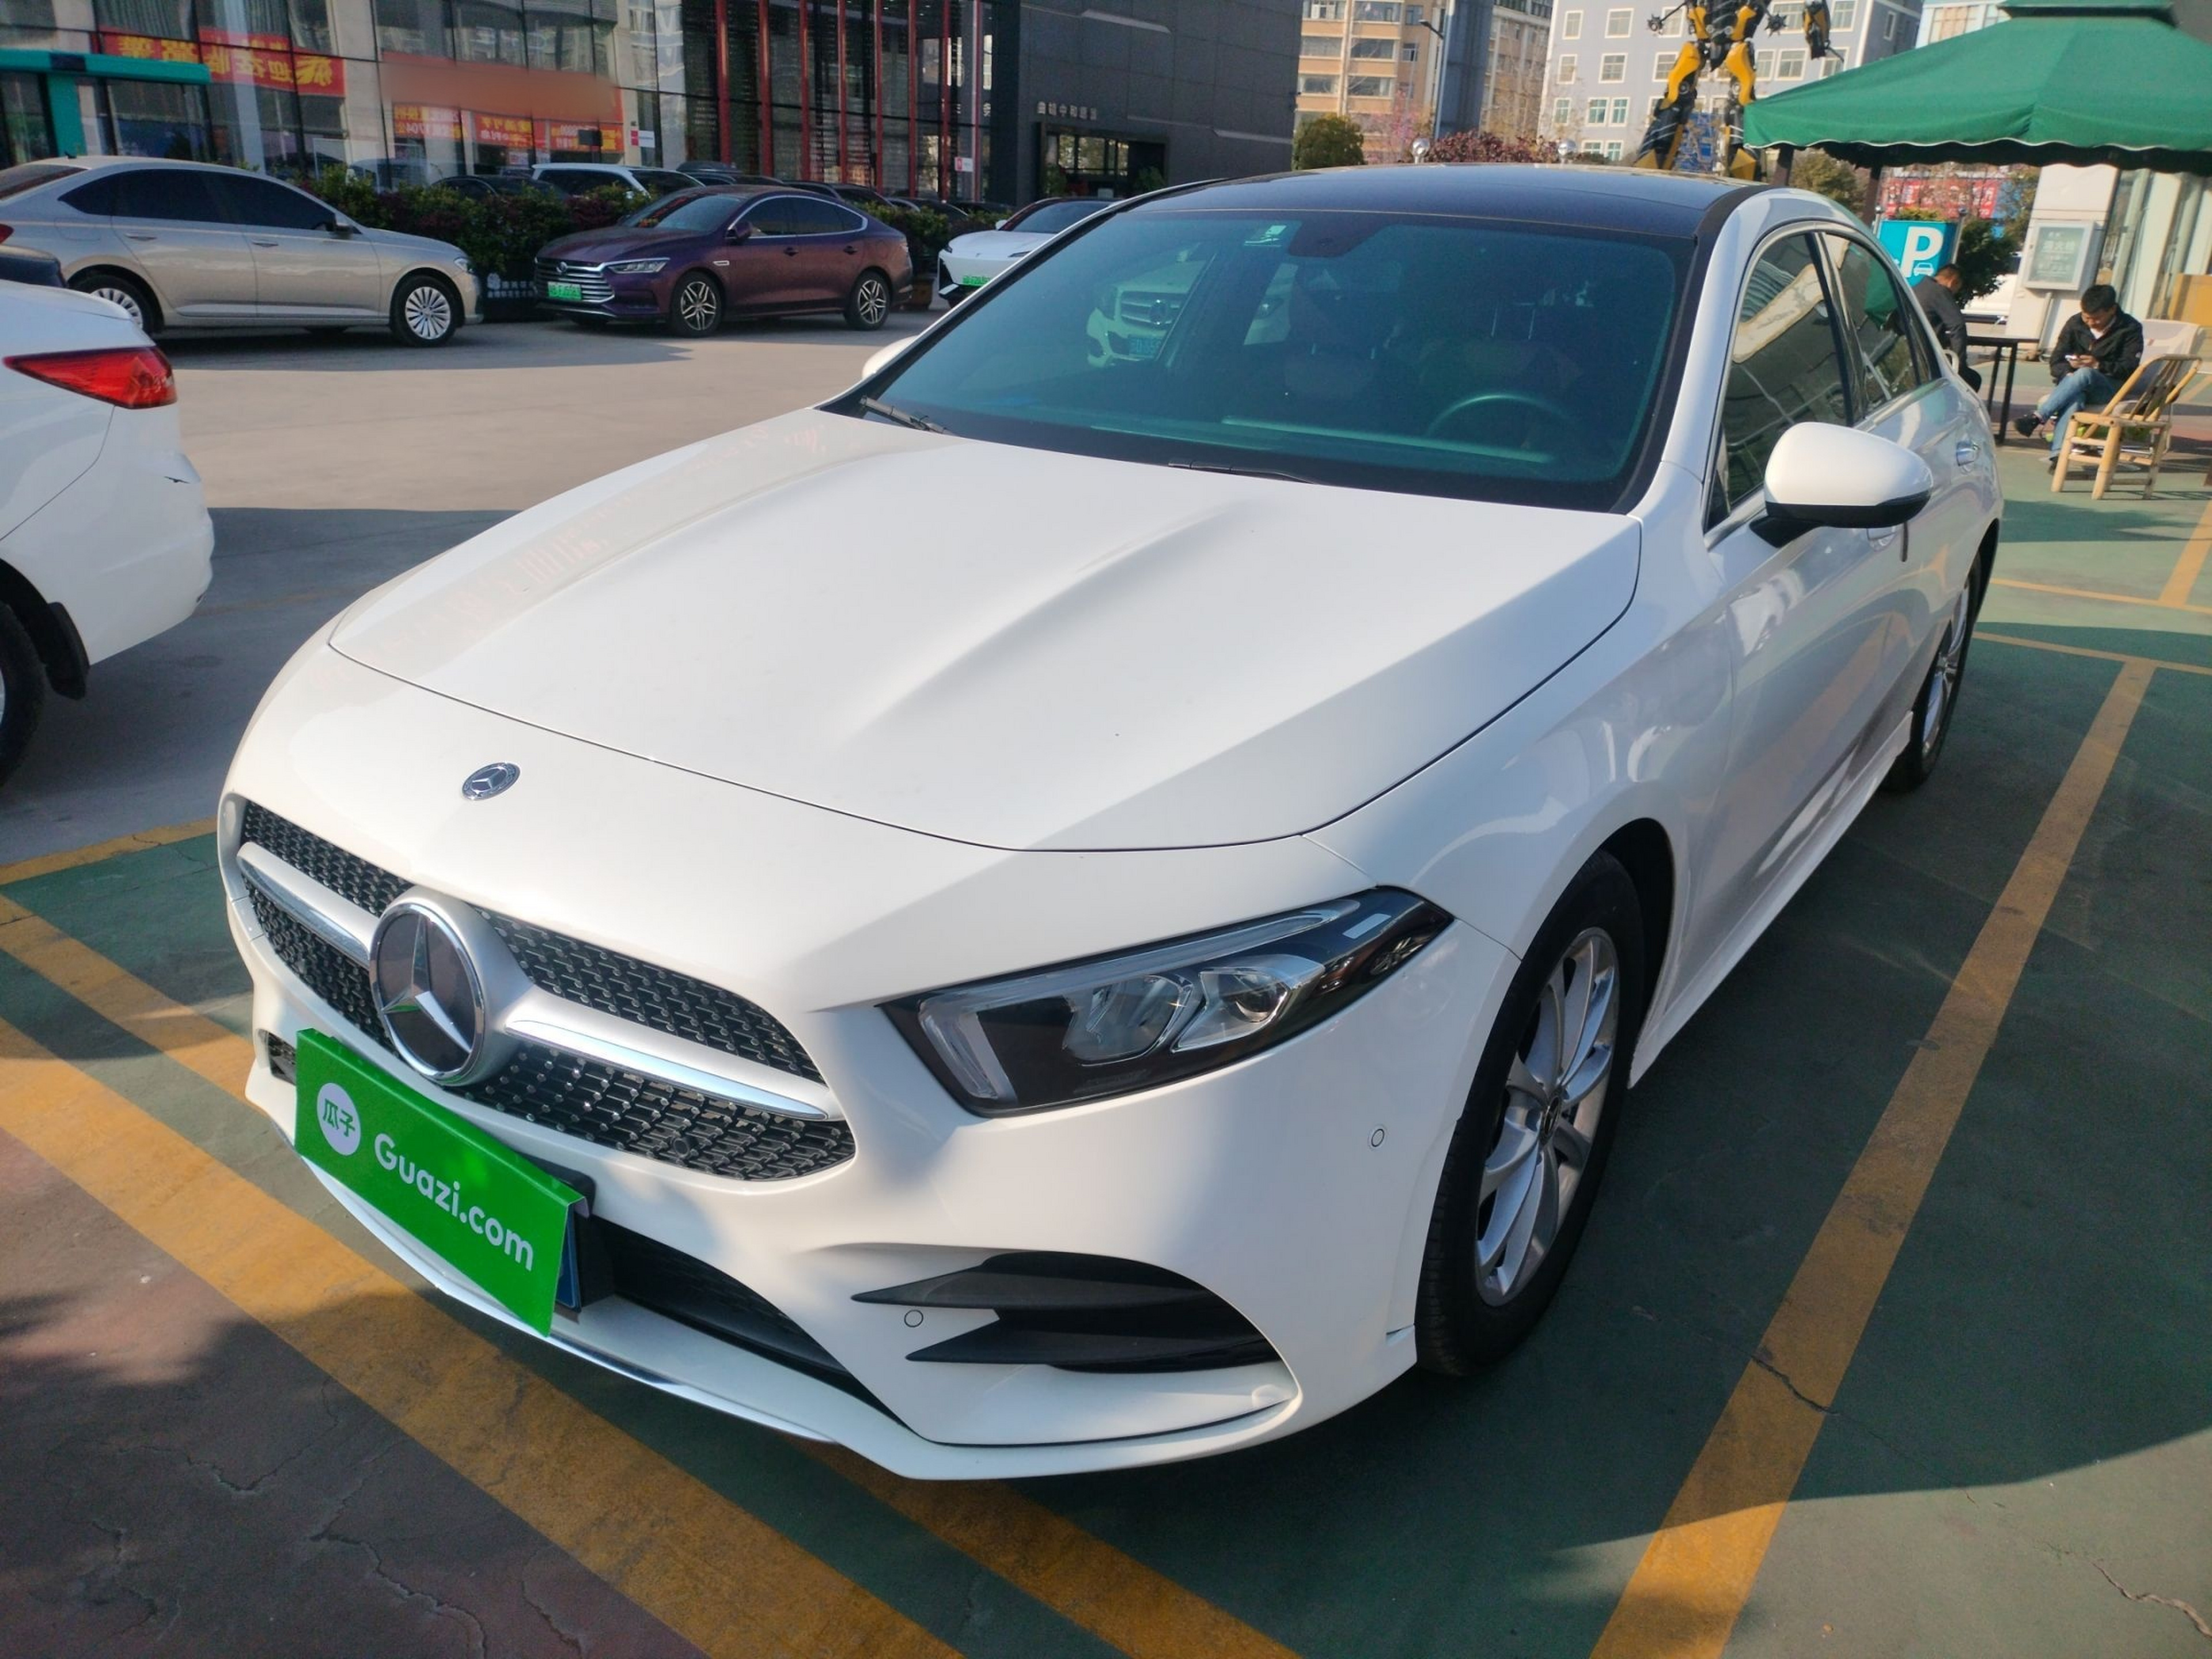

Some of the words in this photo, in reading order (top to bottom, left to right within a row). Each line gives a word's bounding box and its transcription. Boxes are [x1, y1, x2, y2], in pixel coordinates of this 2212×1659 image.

[1900, 226, 1944, 278] P
[323, 1098, 356, 1138] 瓜子
[374, 1132, 534, 1271] Guazi.com
